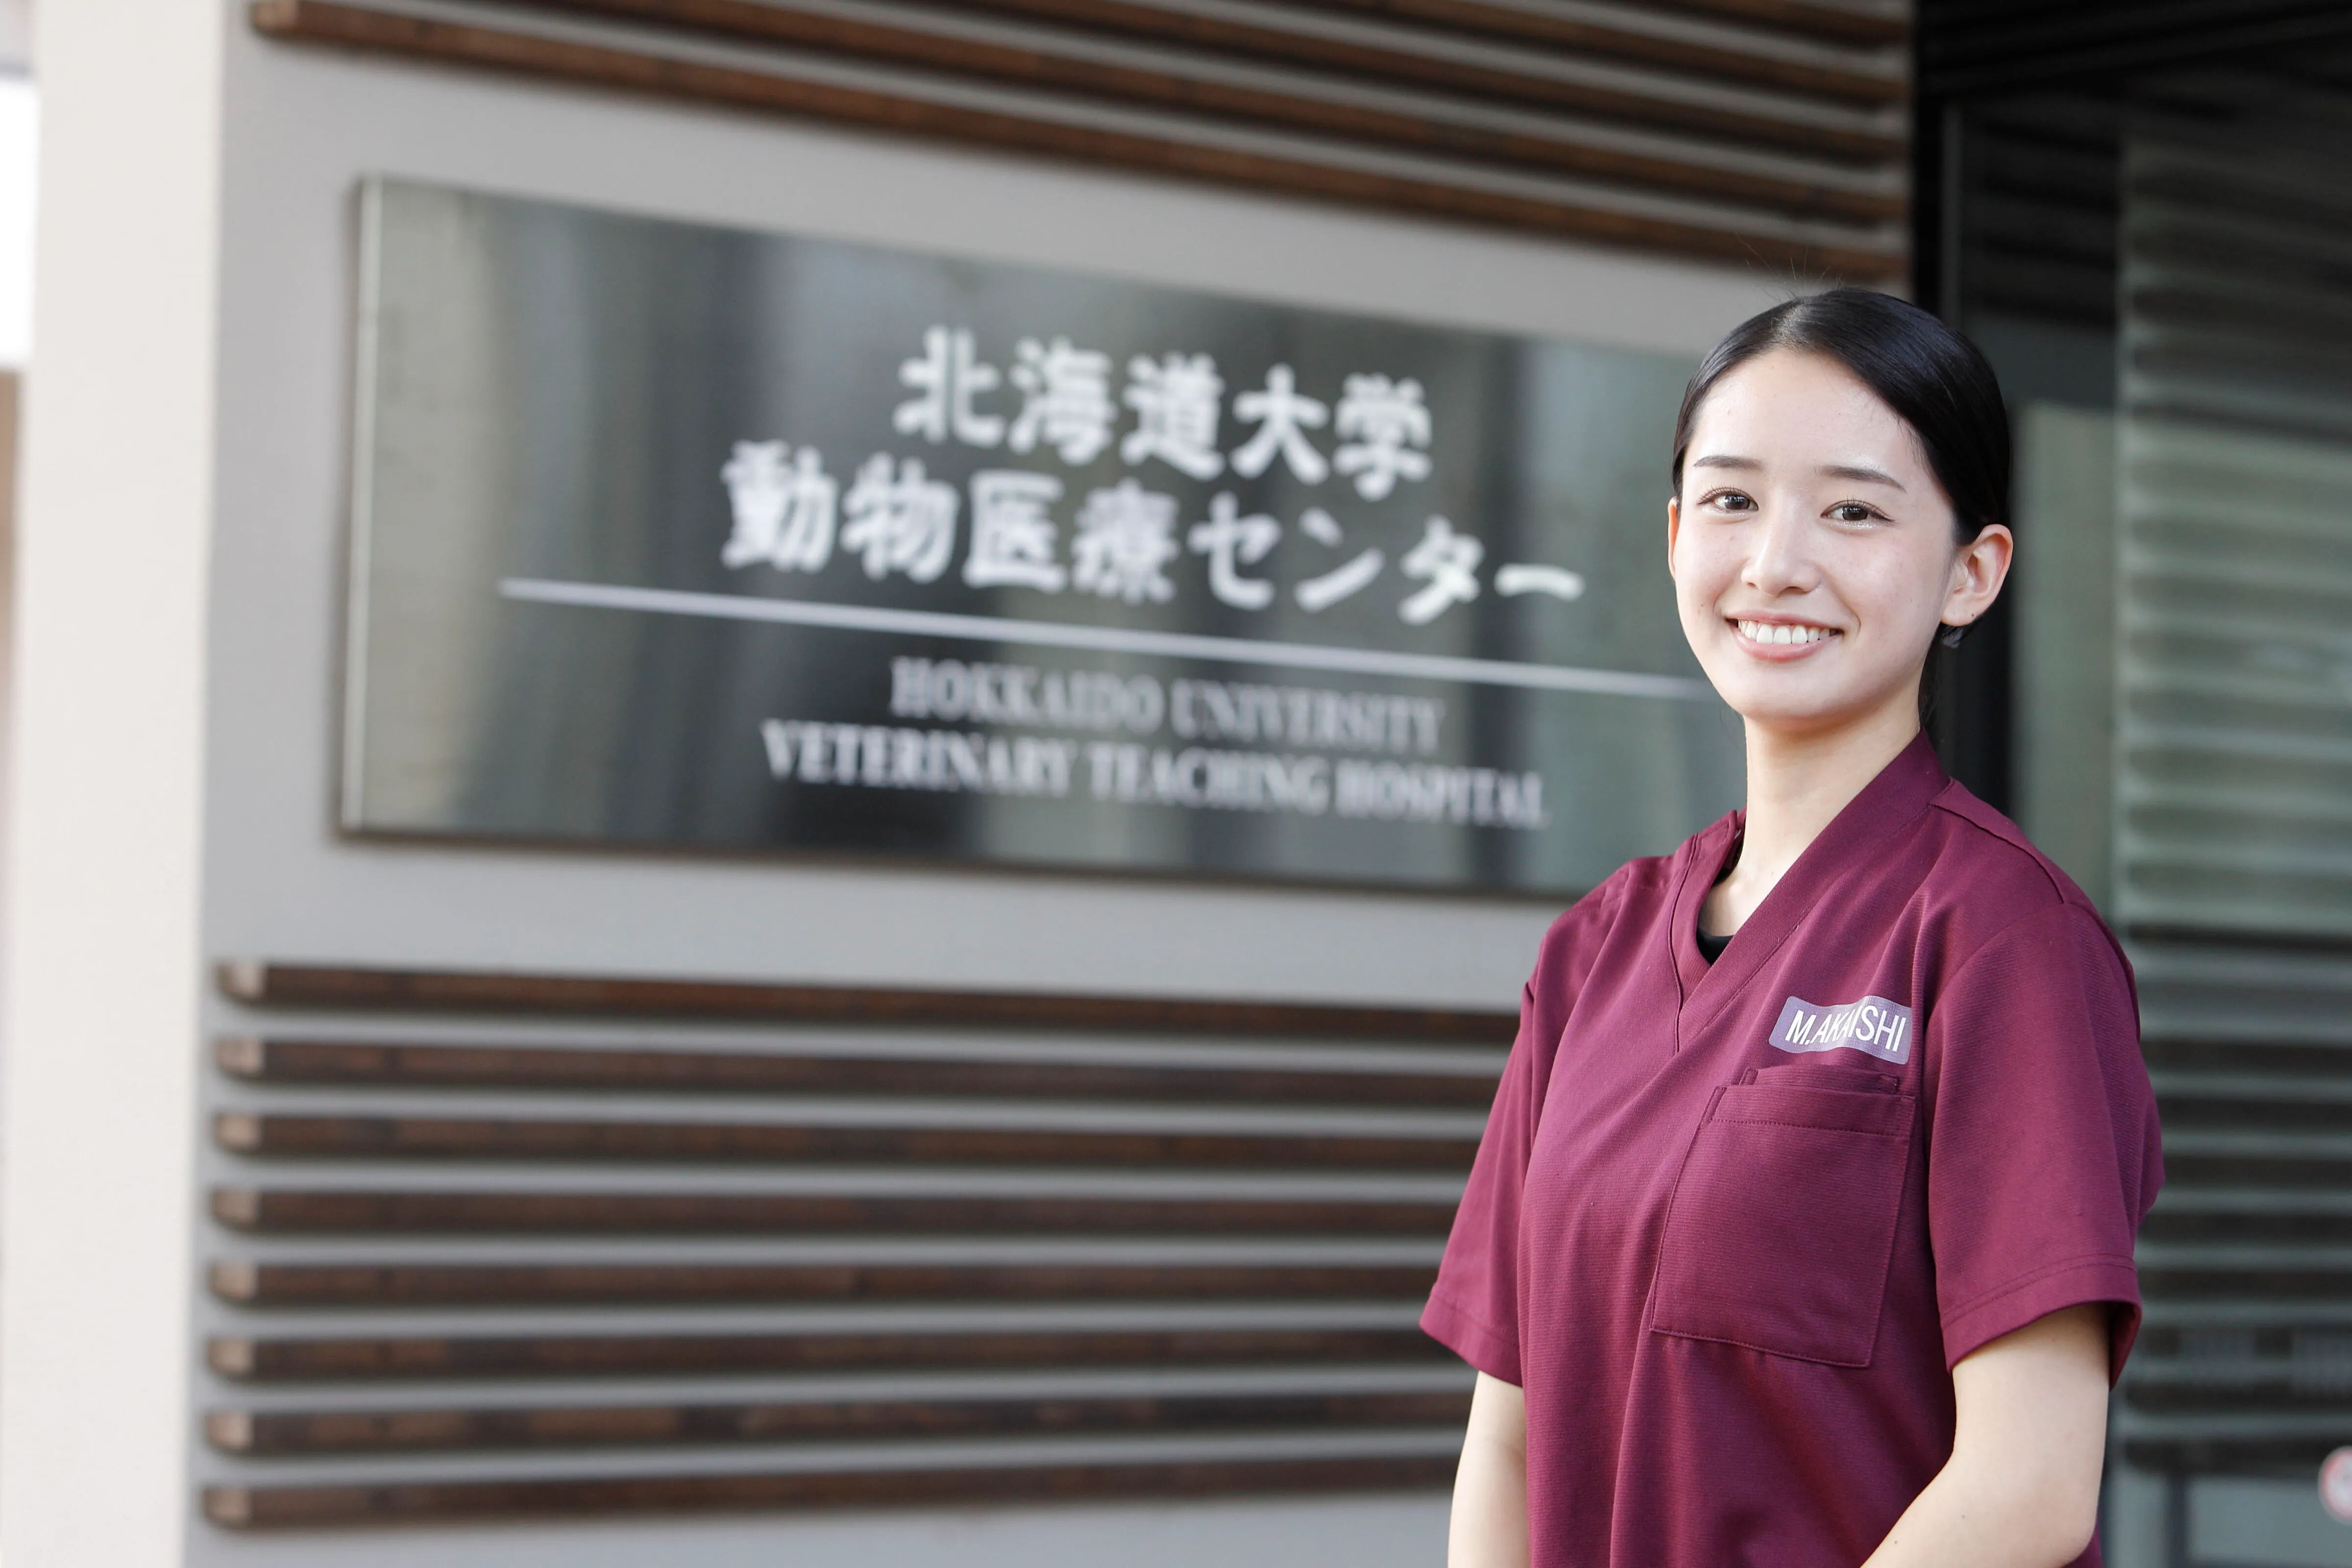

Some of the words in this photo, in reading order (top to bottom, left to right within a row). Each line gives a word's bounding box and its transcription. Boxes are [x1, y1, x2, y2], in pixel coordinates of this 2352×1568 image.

[893, 324, 1432, 500] 北海道大学
[722, 439, 1586, 626] 動物医療センター
[890, 656, 1166, 735] HOKKAIDO
[1171, 678, 1443, 755] UNIVERSITY
[760, 718, 1076, 798] VETERINARY
[1086, 740, 1330, 816] TEACHING
[1334, 758, 1551, 830] HOSPITAL
[1785, 1005, 1906, 1052] M.AKAISHI
